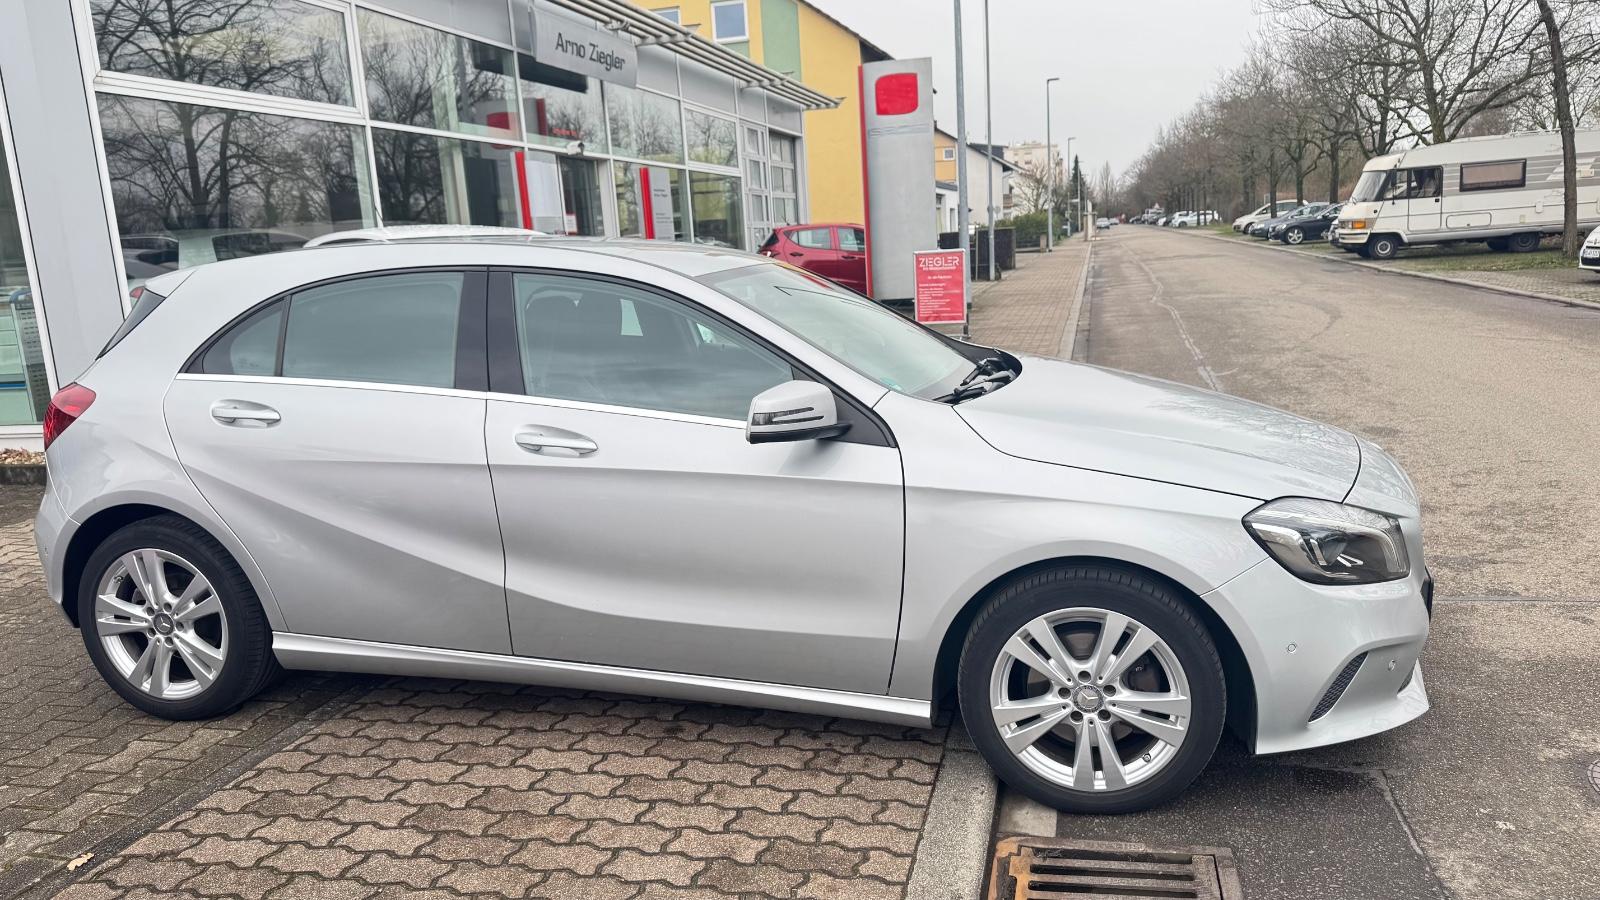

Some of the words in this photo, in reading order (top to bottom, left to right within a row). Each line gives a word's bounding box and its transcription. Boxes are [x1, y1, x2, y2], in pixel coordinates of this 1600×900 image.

[555, 32, 586, 58] Arno
[589, 43, 626, 71] Ziegler
[918, 256, 960, 267] ZIEGLER
